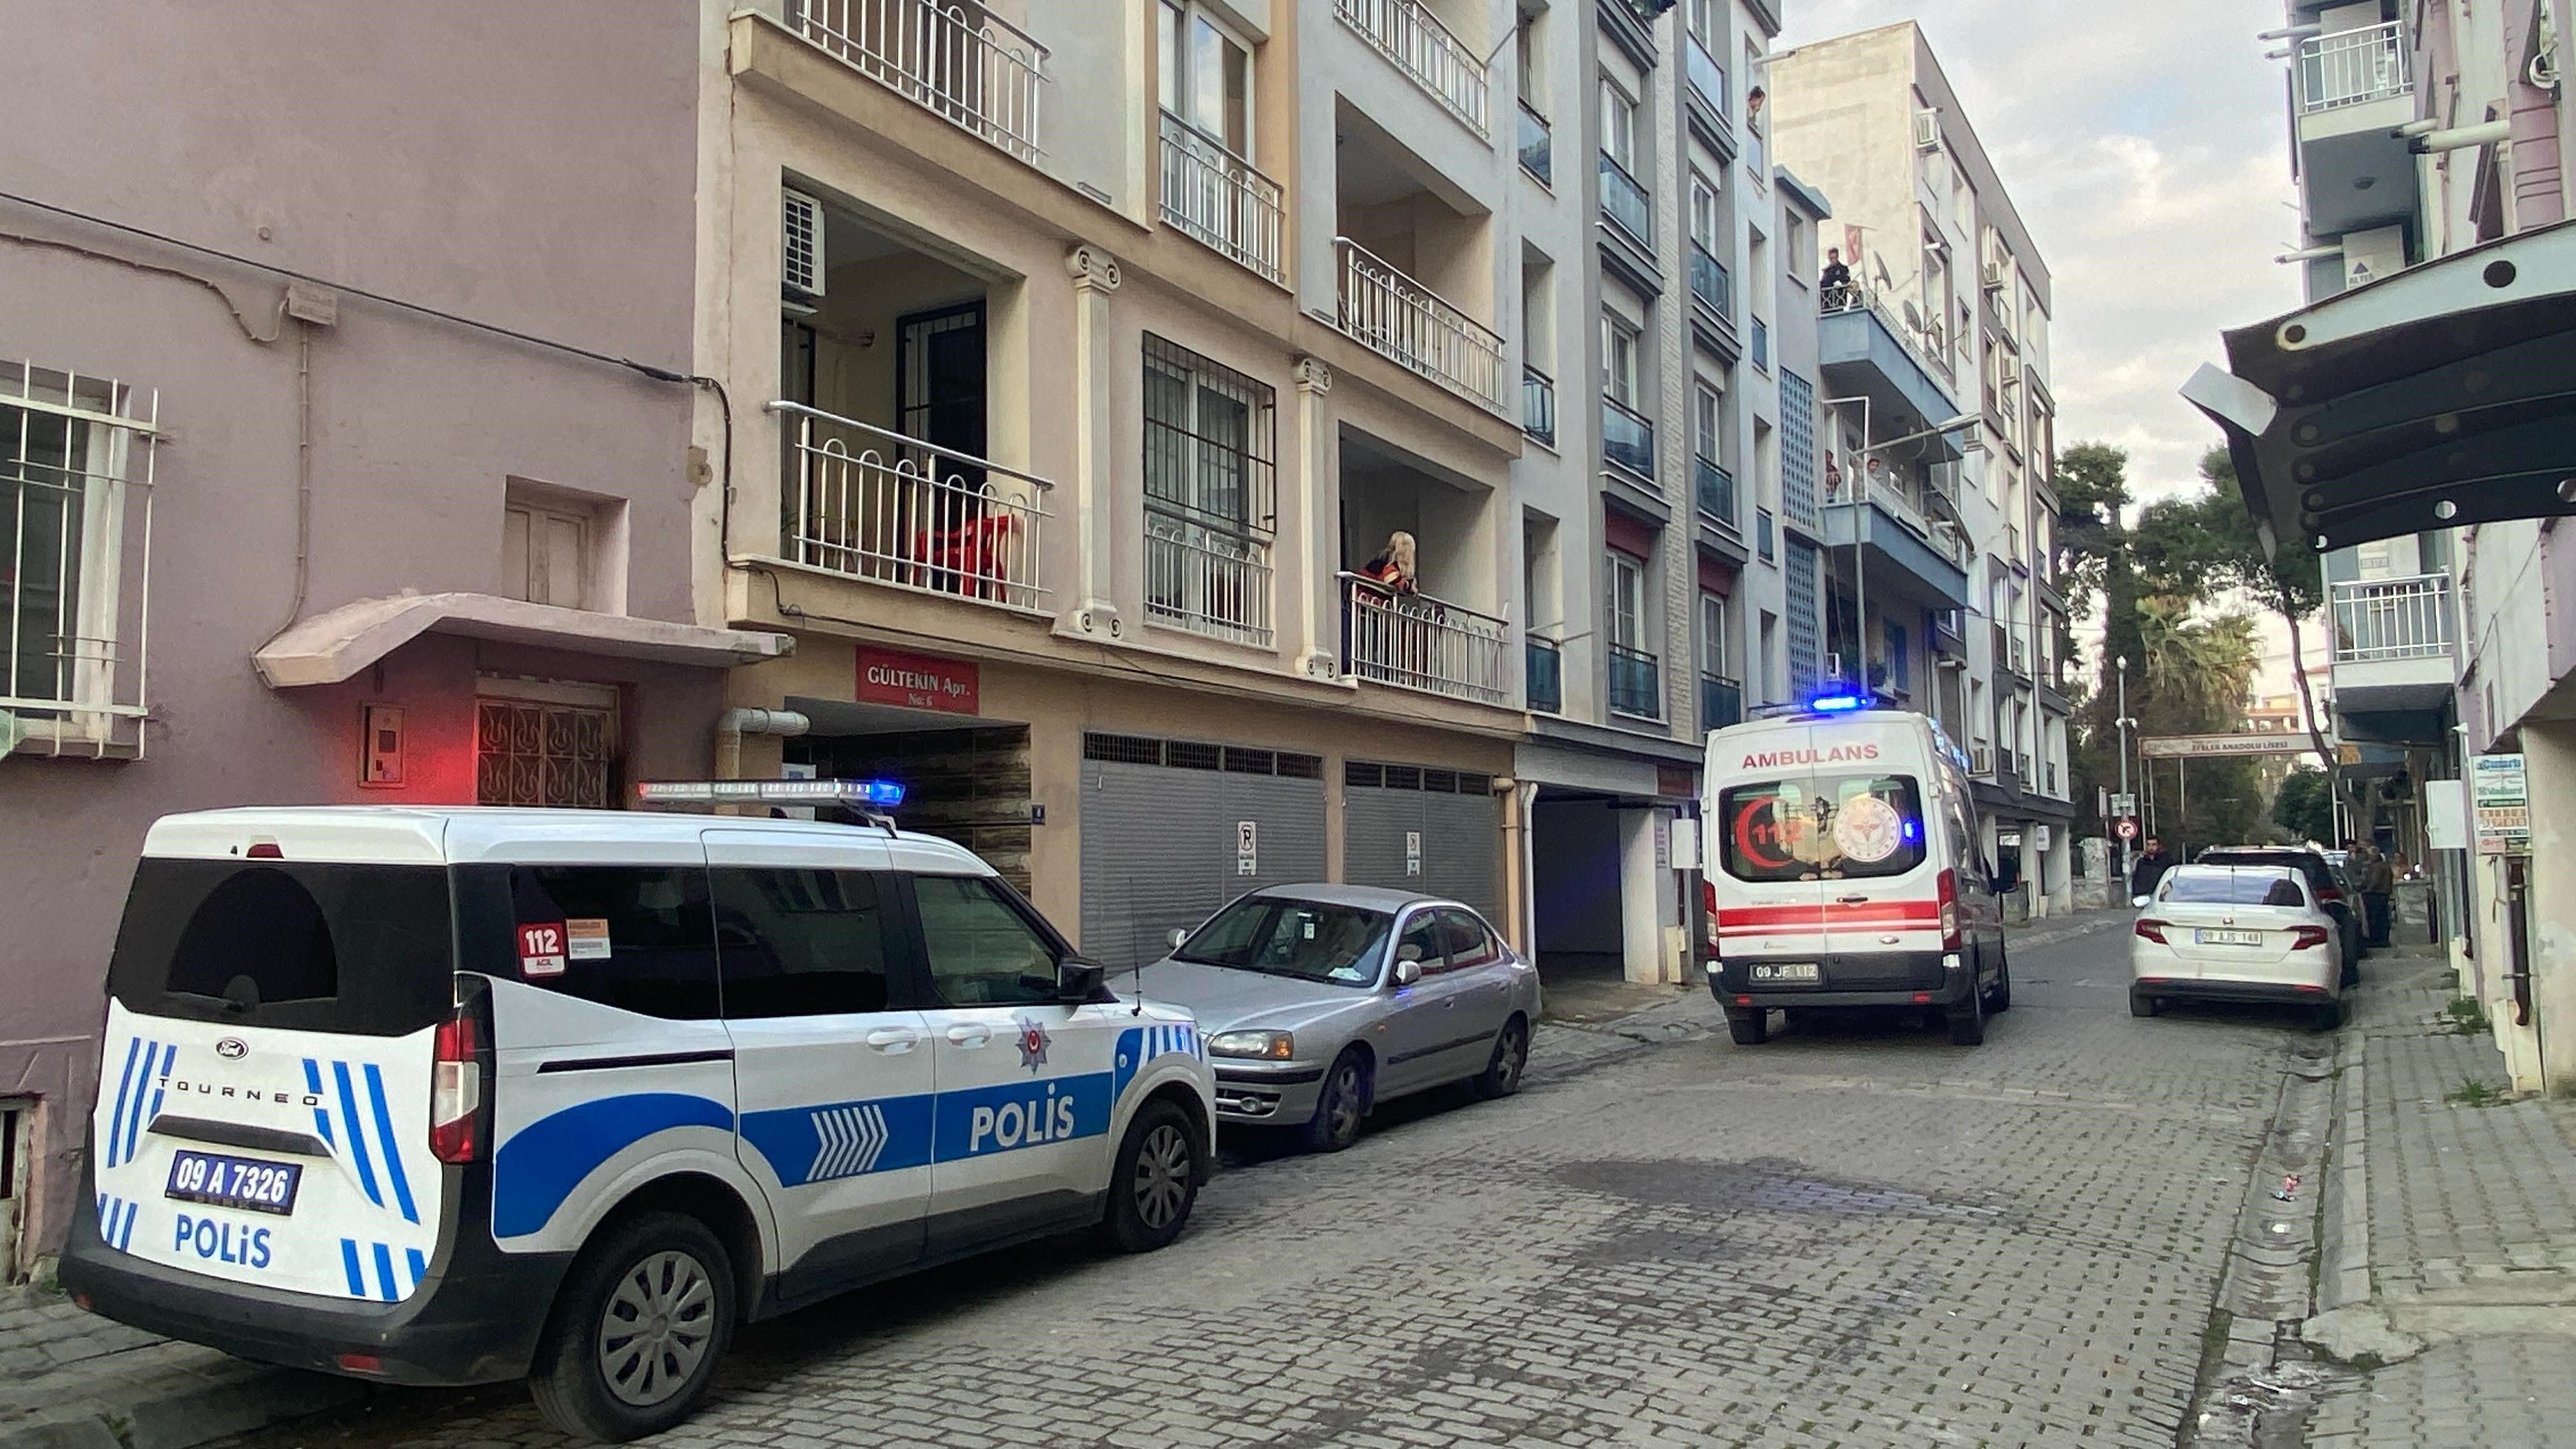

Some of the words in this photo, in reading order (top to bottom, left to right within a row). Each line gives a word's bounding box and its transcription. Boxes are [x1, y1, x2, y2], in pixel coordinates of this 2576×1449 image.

[867, 663, 939, 691] GÜLTEKİN
[1742, 744, 1879, 769] AMBULANS
[525, 929, 559, 954] 112
[1756, 966, 1772, 978] 09
[1796, 964, 1816, 977] 112
[158, 1077, 319, 1107] TOURNEO
[176, 1157, 207, 1191] 09
[206, 1161, 226, 1195] A
[230, 1164, 289, 1204] 7326
